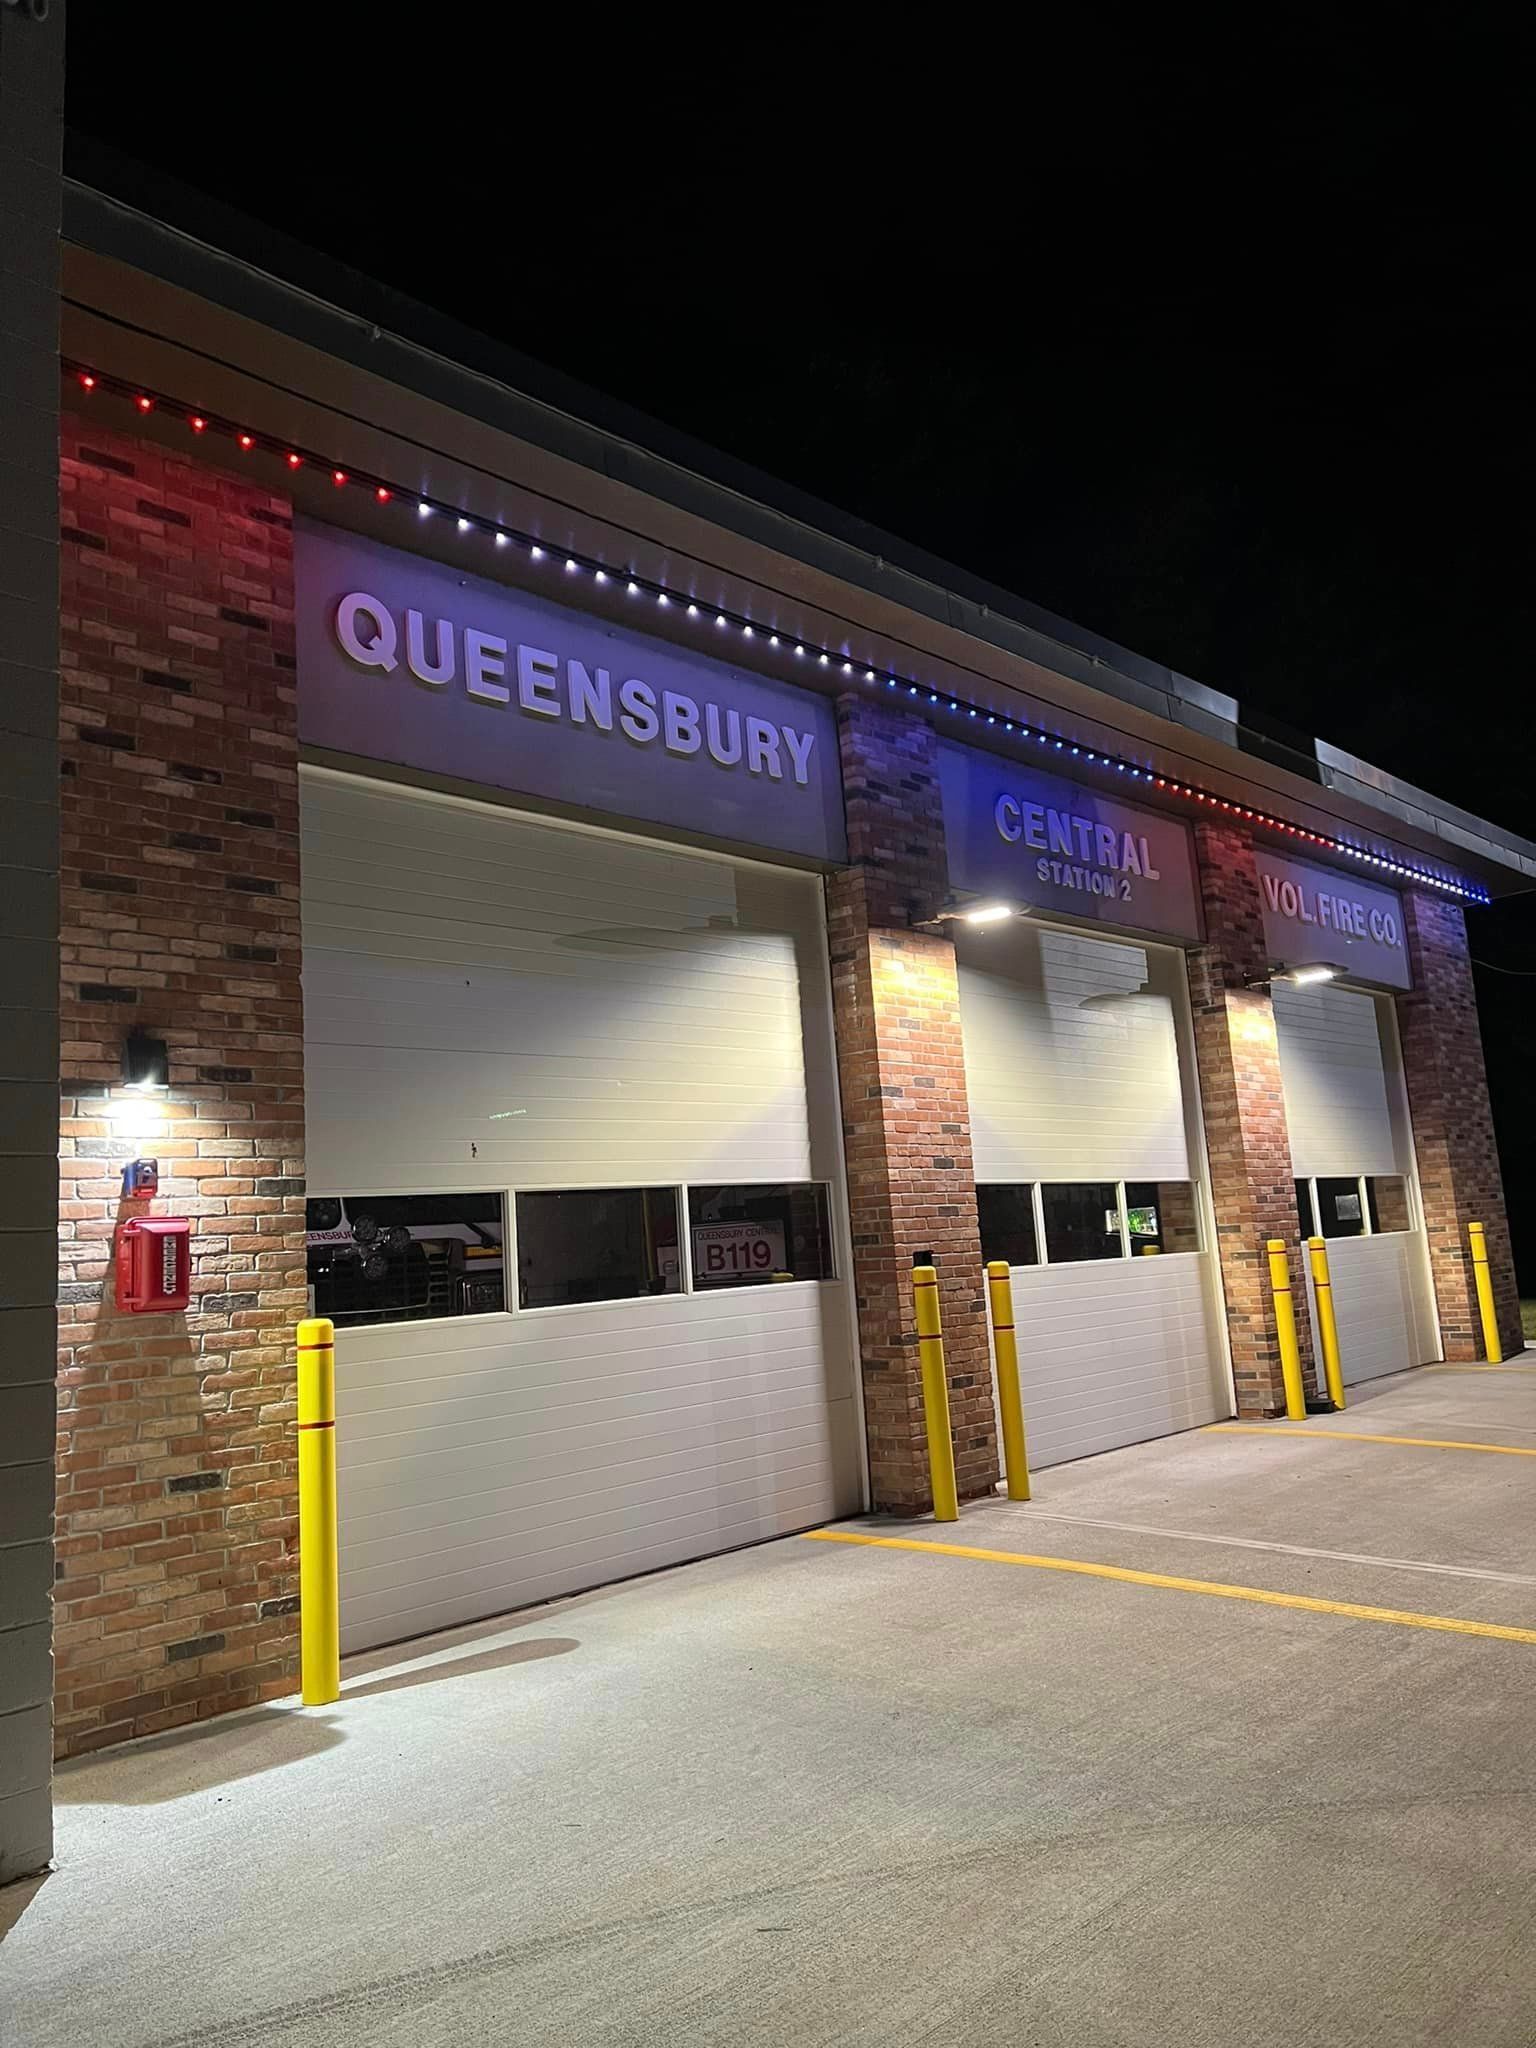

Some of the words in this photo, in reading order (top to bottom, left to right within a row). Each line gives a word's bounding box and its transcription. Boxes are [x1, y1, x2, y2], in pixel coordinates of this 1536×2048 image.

[335, 592, 815, 784] QUEENSBURY
[995, 794, 1160, 881] CENTRAL
[1037, 857, 1116, 898] STATION
[1120, 879, 1132, 901] 2
[1368, 908, 1402, 947] CO.
[706, 1240, 771, 1271] B119
